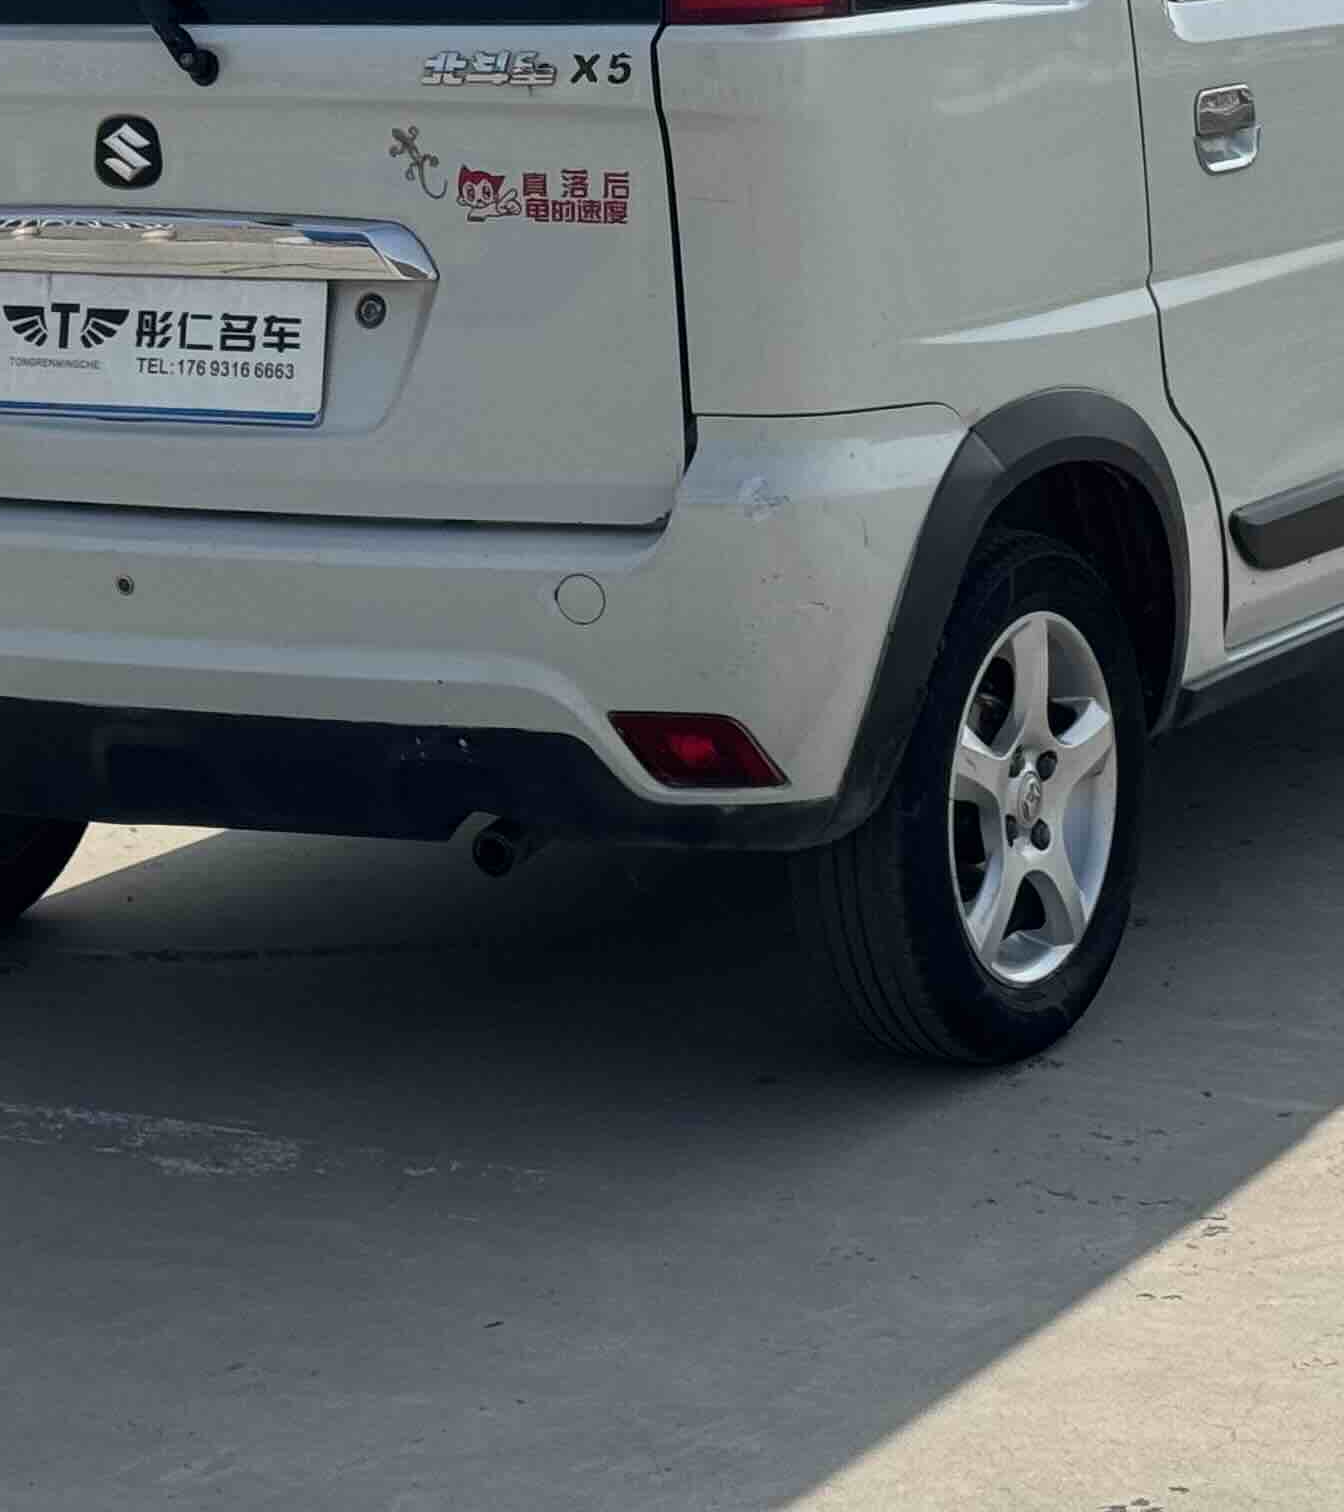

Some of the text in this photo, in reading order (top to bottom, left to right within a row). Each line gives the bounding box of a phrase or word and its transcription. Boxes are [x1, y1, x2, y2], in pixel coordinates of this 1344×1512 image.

[569, 52, 633, 85] X5
[135, 310, 303, 354] 彤仁名车
[209, 359, 251, 379] 9316
[254, 361, 296, 381] 6663
